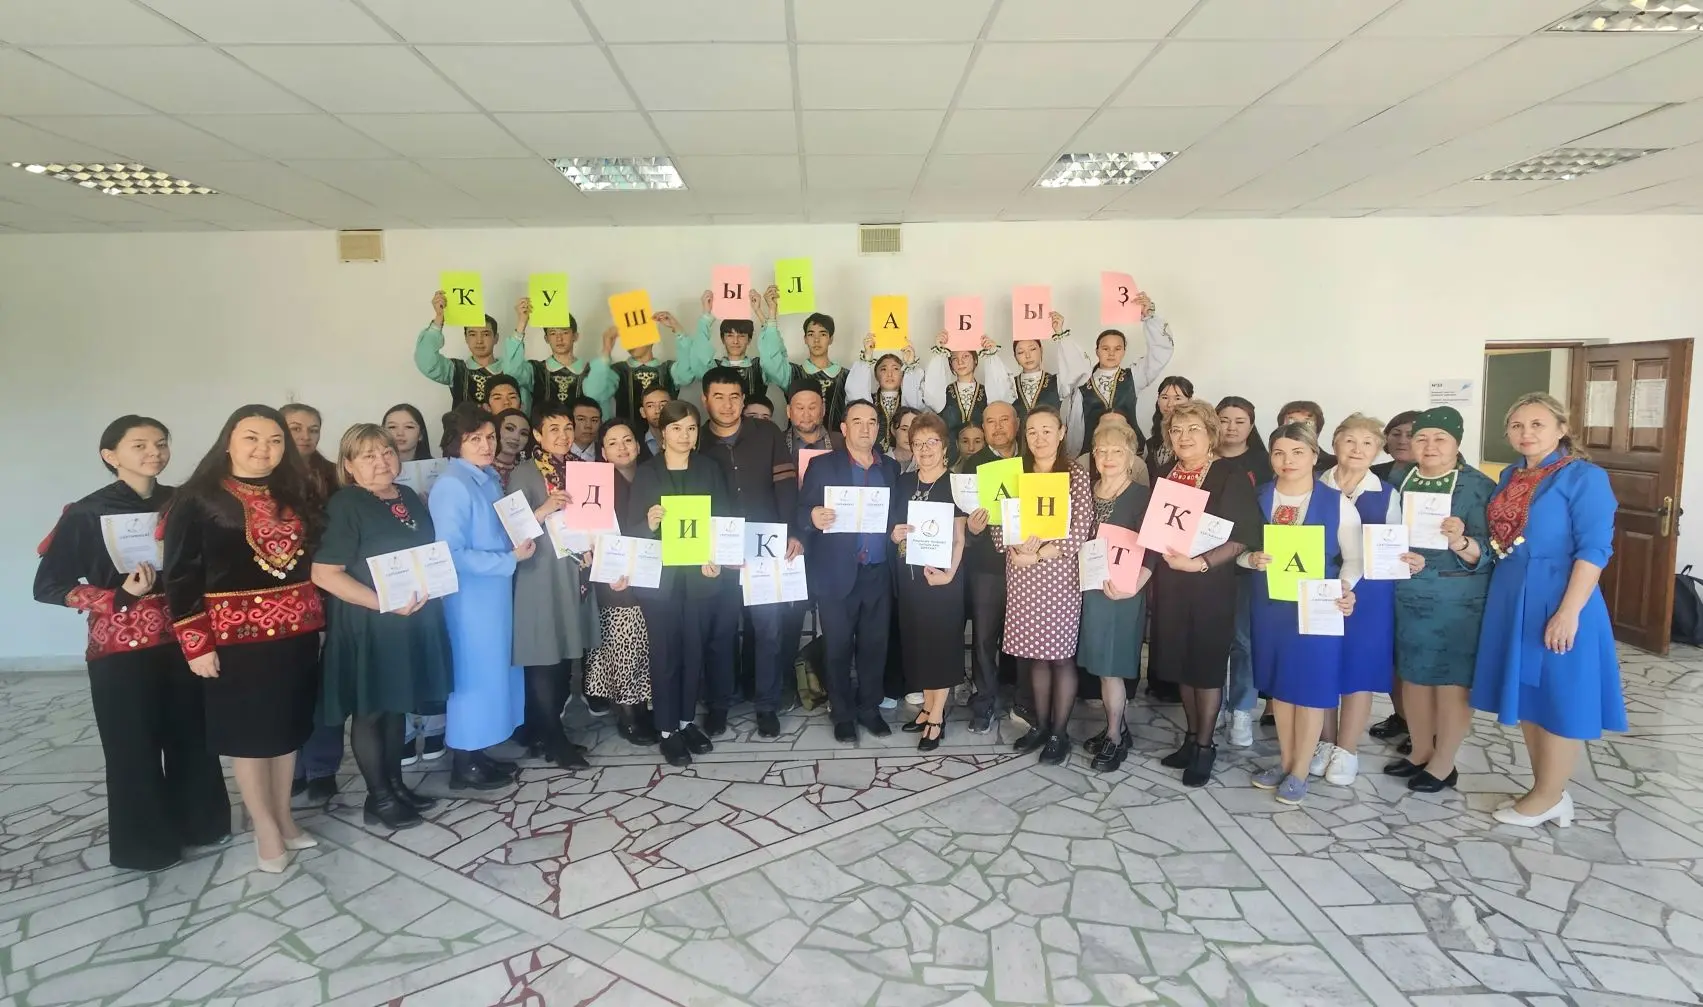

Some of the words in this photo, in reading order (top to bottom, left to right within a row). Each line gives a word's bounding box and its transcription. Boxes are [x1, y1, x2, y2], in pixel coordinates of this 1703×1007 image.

[723, 282, 742, 300] Ы
[787, 276, 803, 293] Л
[542, 290, 557, 306] У
[624, 309, 647, 328] Ш
[883, 312, 899, 329] А
[1024, 303, 1043, 320] Ы
[959, 314, 972, 331] Б
[581, 485, 602, 509] Д
[993, 482, 1012, 501] А
[1037, 496, 1055, 517] Н
[678, 519, 698, 539] И
[755, 533, 780, 558] К
[1112, 545, 1131, 565] Т
[1284, 550, 1308, 573] А
